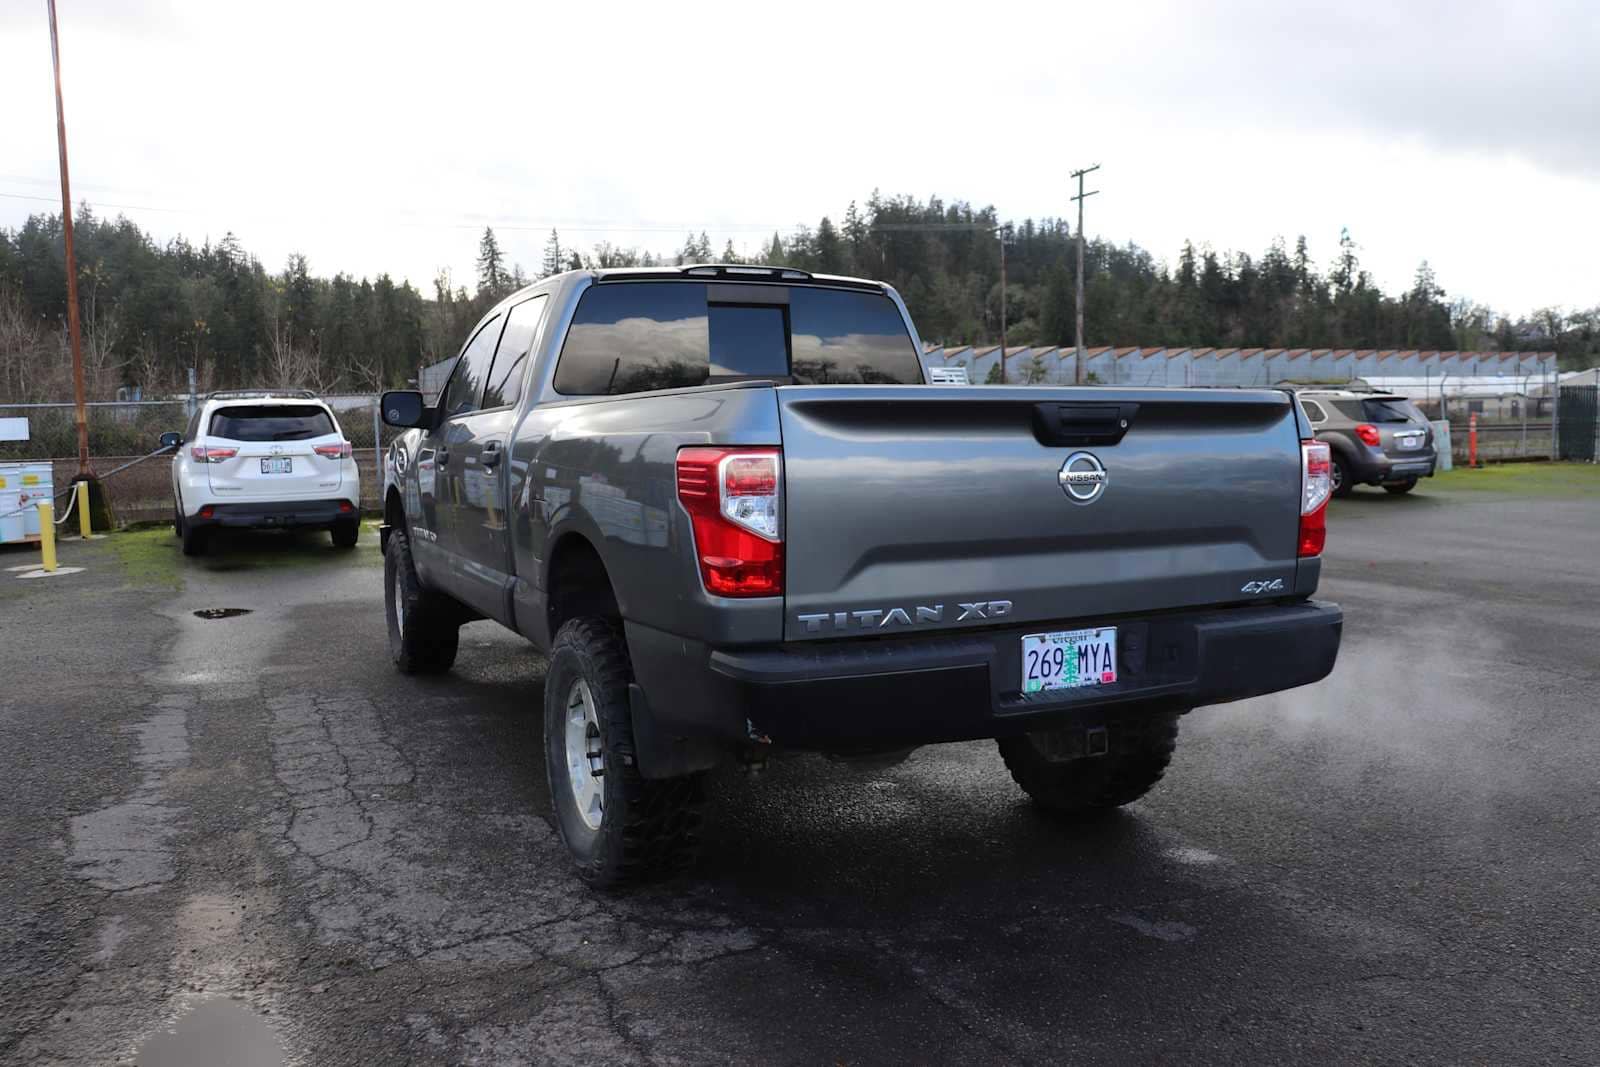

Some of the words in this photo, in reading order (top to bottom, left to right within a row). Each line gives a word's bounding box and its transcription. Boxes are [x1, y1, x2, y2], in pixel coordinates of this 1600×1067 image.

[1065, 473, 1103, 482] NISSAN
[797, 604, 944, 632] TITAN
[957, 600, 1013, 621] XD
[1028, 647, 1064, 680] 269
[1078, 642, 1112, 674] MYA
